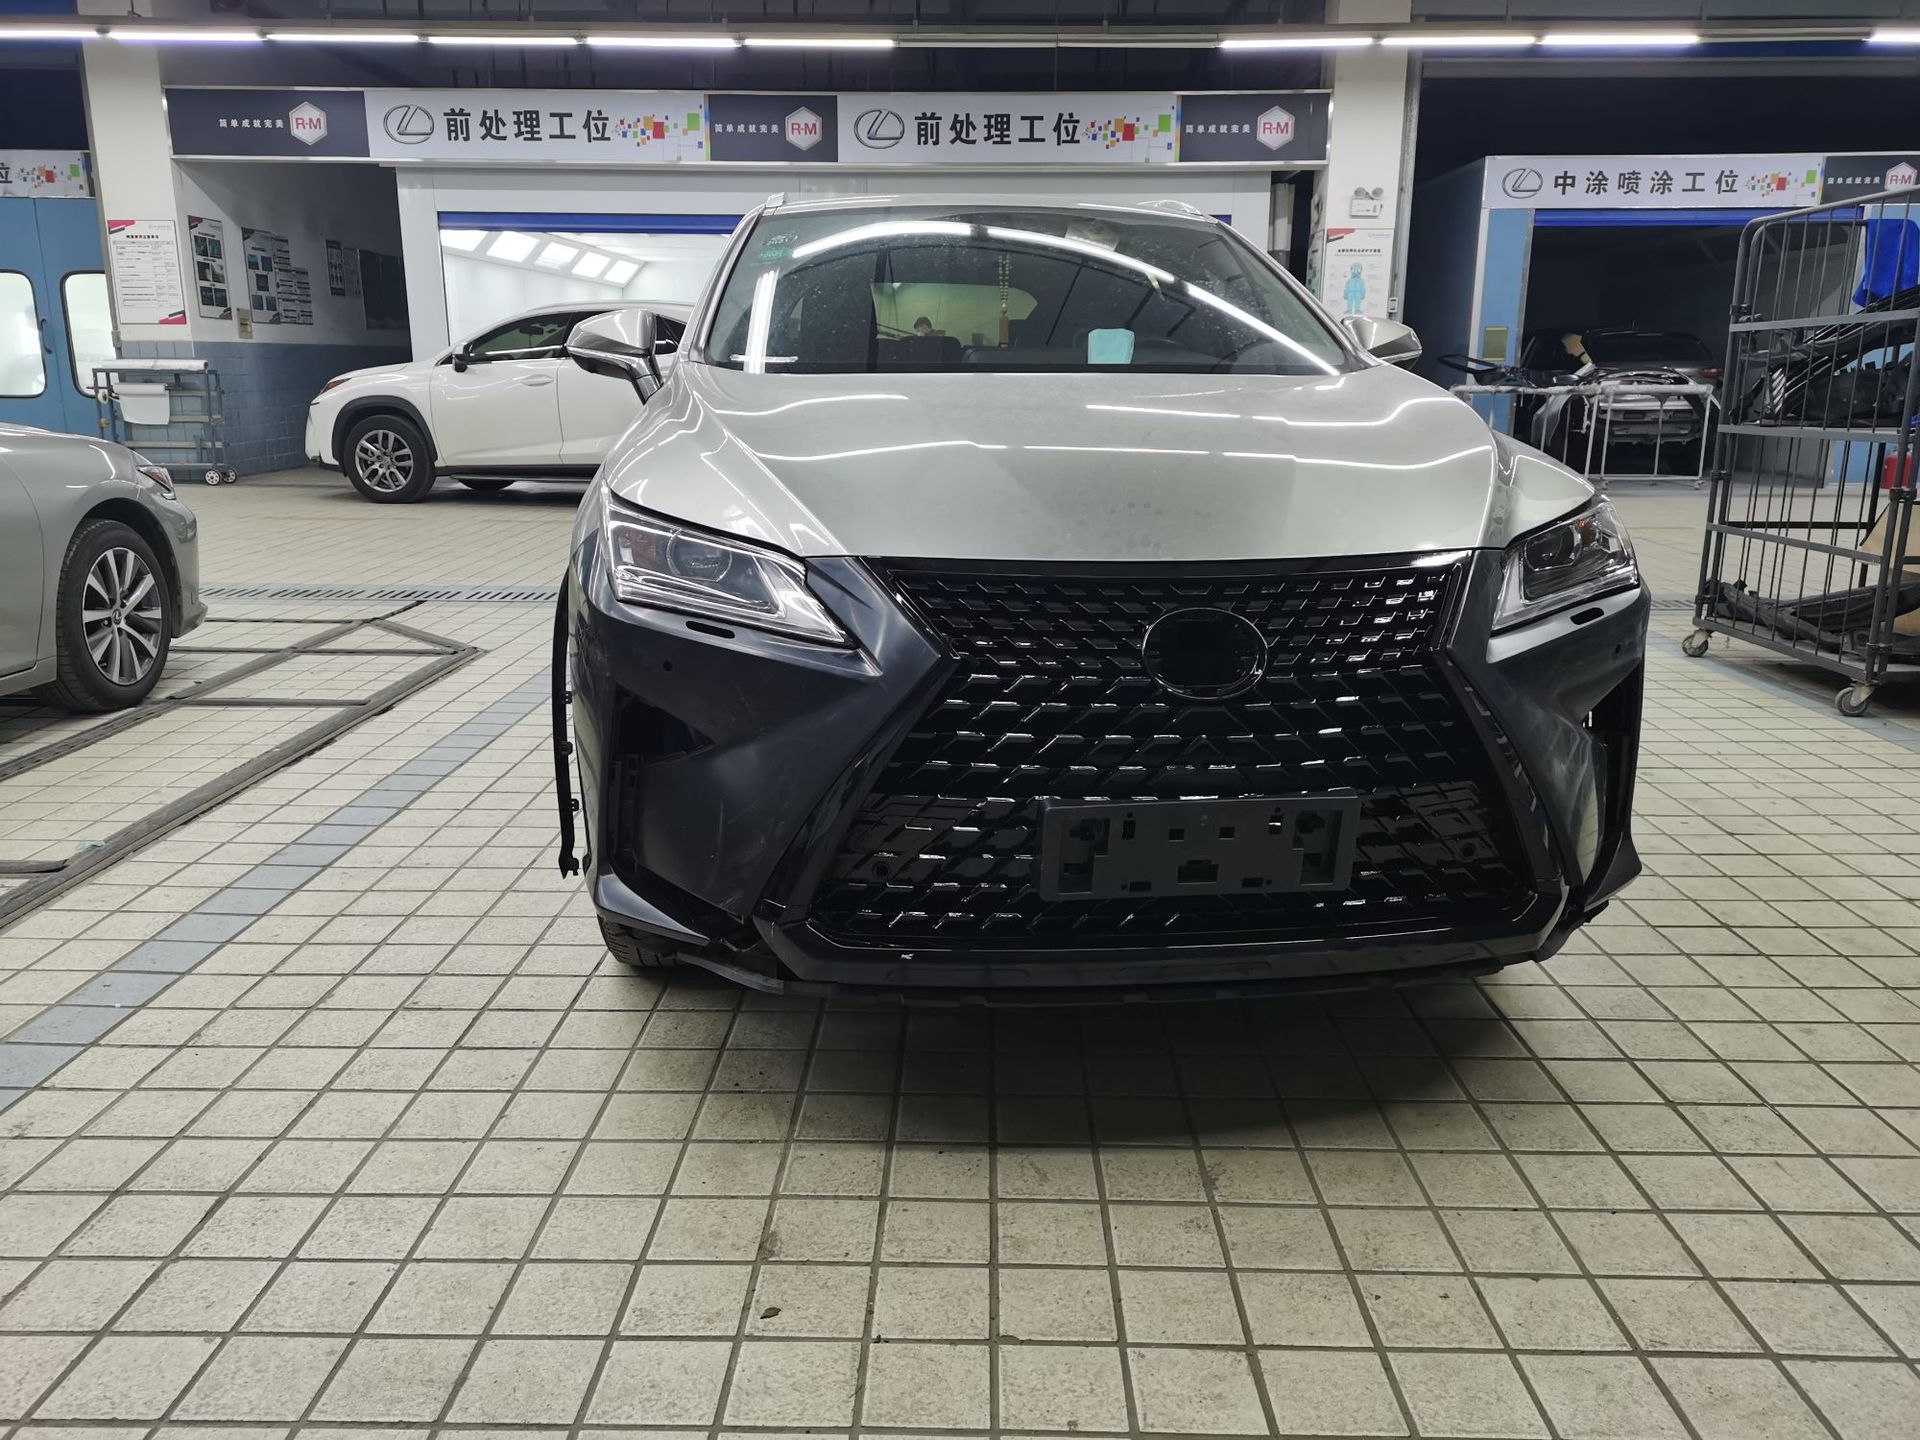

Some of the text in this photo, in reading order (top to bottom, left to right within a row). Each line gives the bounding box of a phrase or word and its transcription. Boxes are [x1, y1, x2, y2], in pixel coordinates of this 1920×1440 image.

[443, 107, 612, 143] 前处理工位
[914, 111, 1081, 146] 前处理工位
[1553, 169, 1740, 196] 中涂喷涂工位
